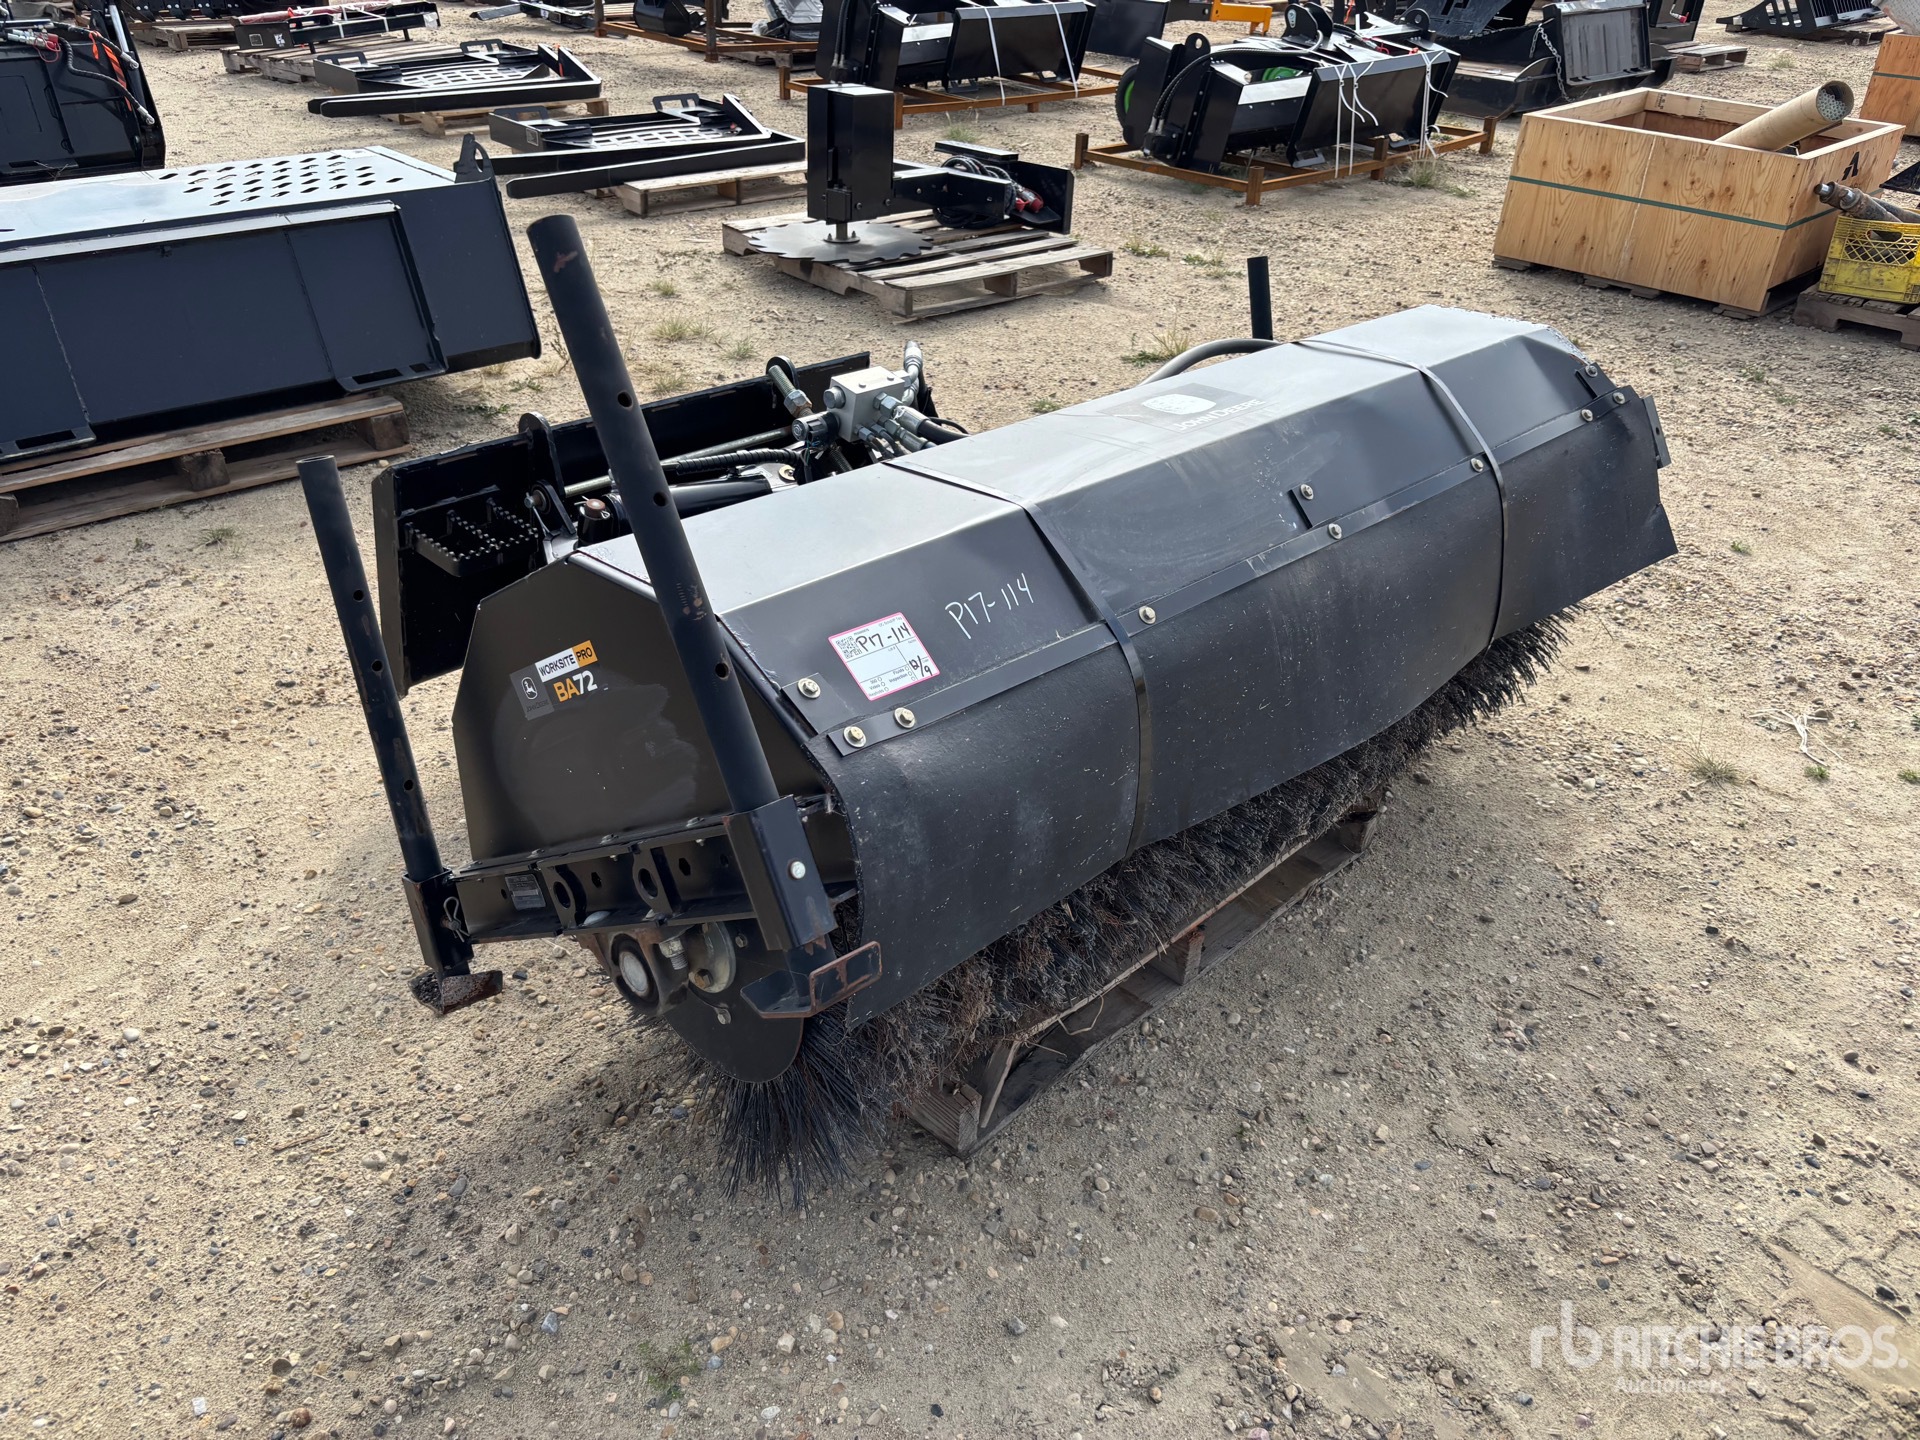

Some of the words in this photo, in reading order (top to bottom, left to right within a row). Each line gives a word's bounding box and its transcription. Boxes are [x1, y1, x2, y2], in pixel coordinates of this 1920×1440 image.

[1173, 411, 1218, 431] JOHN
[1215, 398, 1266, 417] DEERE
[944, 572, 1034, 640] P17-114
[538, 653, 577, 677] WORKSITE
[575, 646, 593, 662] PRO
[552, 670, 598, 702] BA72
